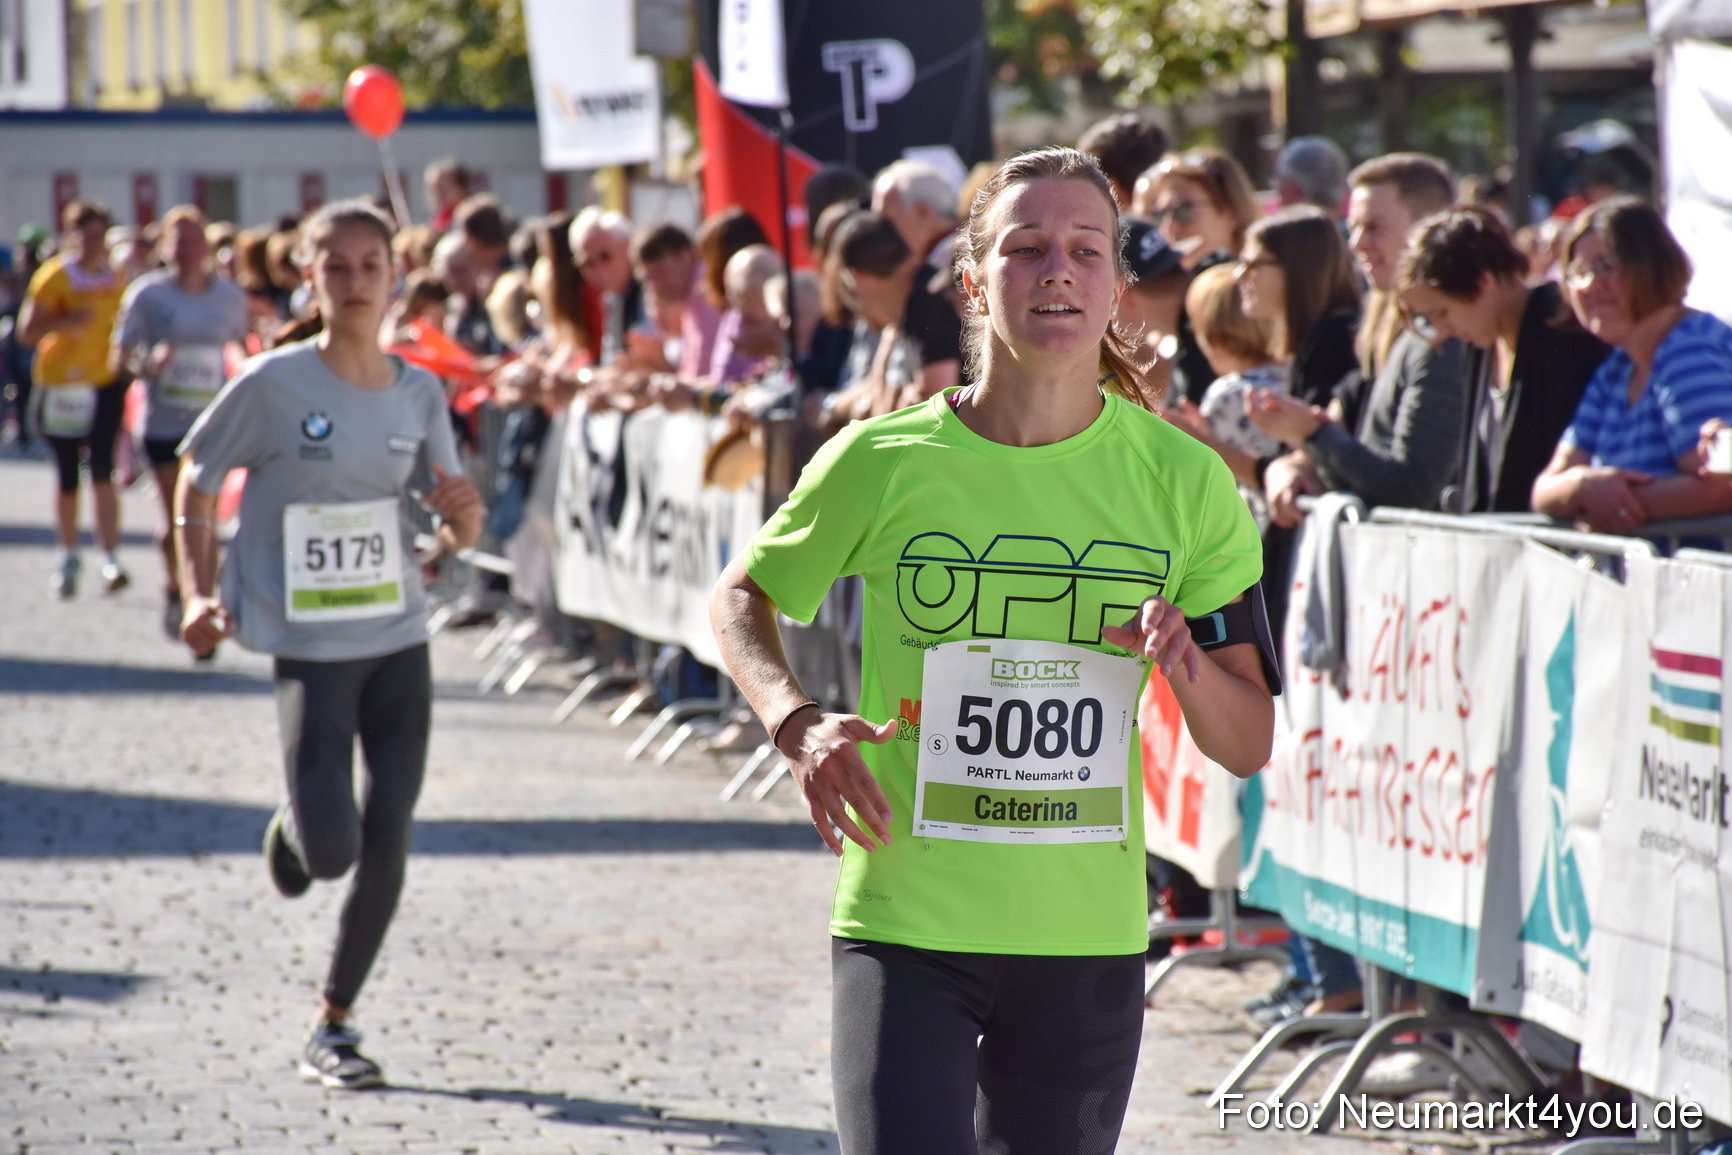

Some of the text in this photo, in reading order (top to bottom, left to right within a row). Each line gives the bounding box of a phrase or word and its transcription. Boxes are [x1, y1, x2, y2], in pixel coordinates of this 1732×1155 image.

[306, 534, 385, 571] 5179
[991, 658, 1081, 681] BOCK
[990, 680, 1019, 689] inspired
[955, 694, 1103, 760] 5080
[933, 739, 942, 752] S
[967, 766, 1074, 782] PARTL Neumarkt
[974, 794, 1078, 822] Caterina
